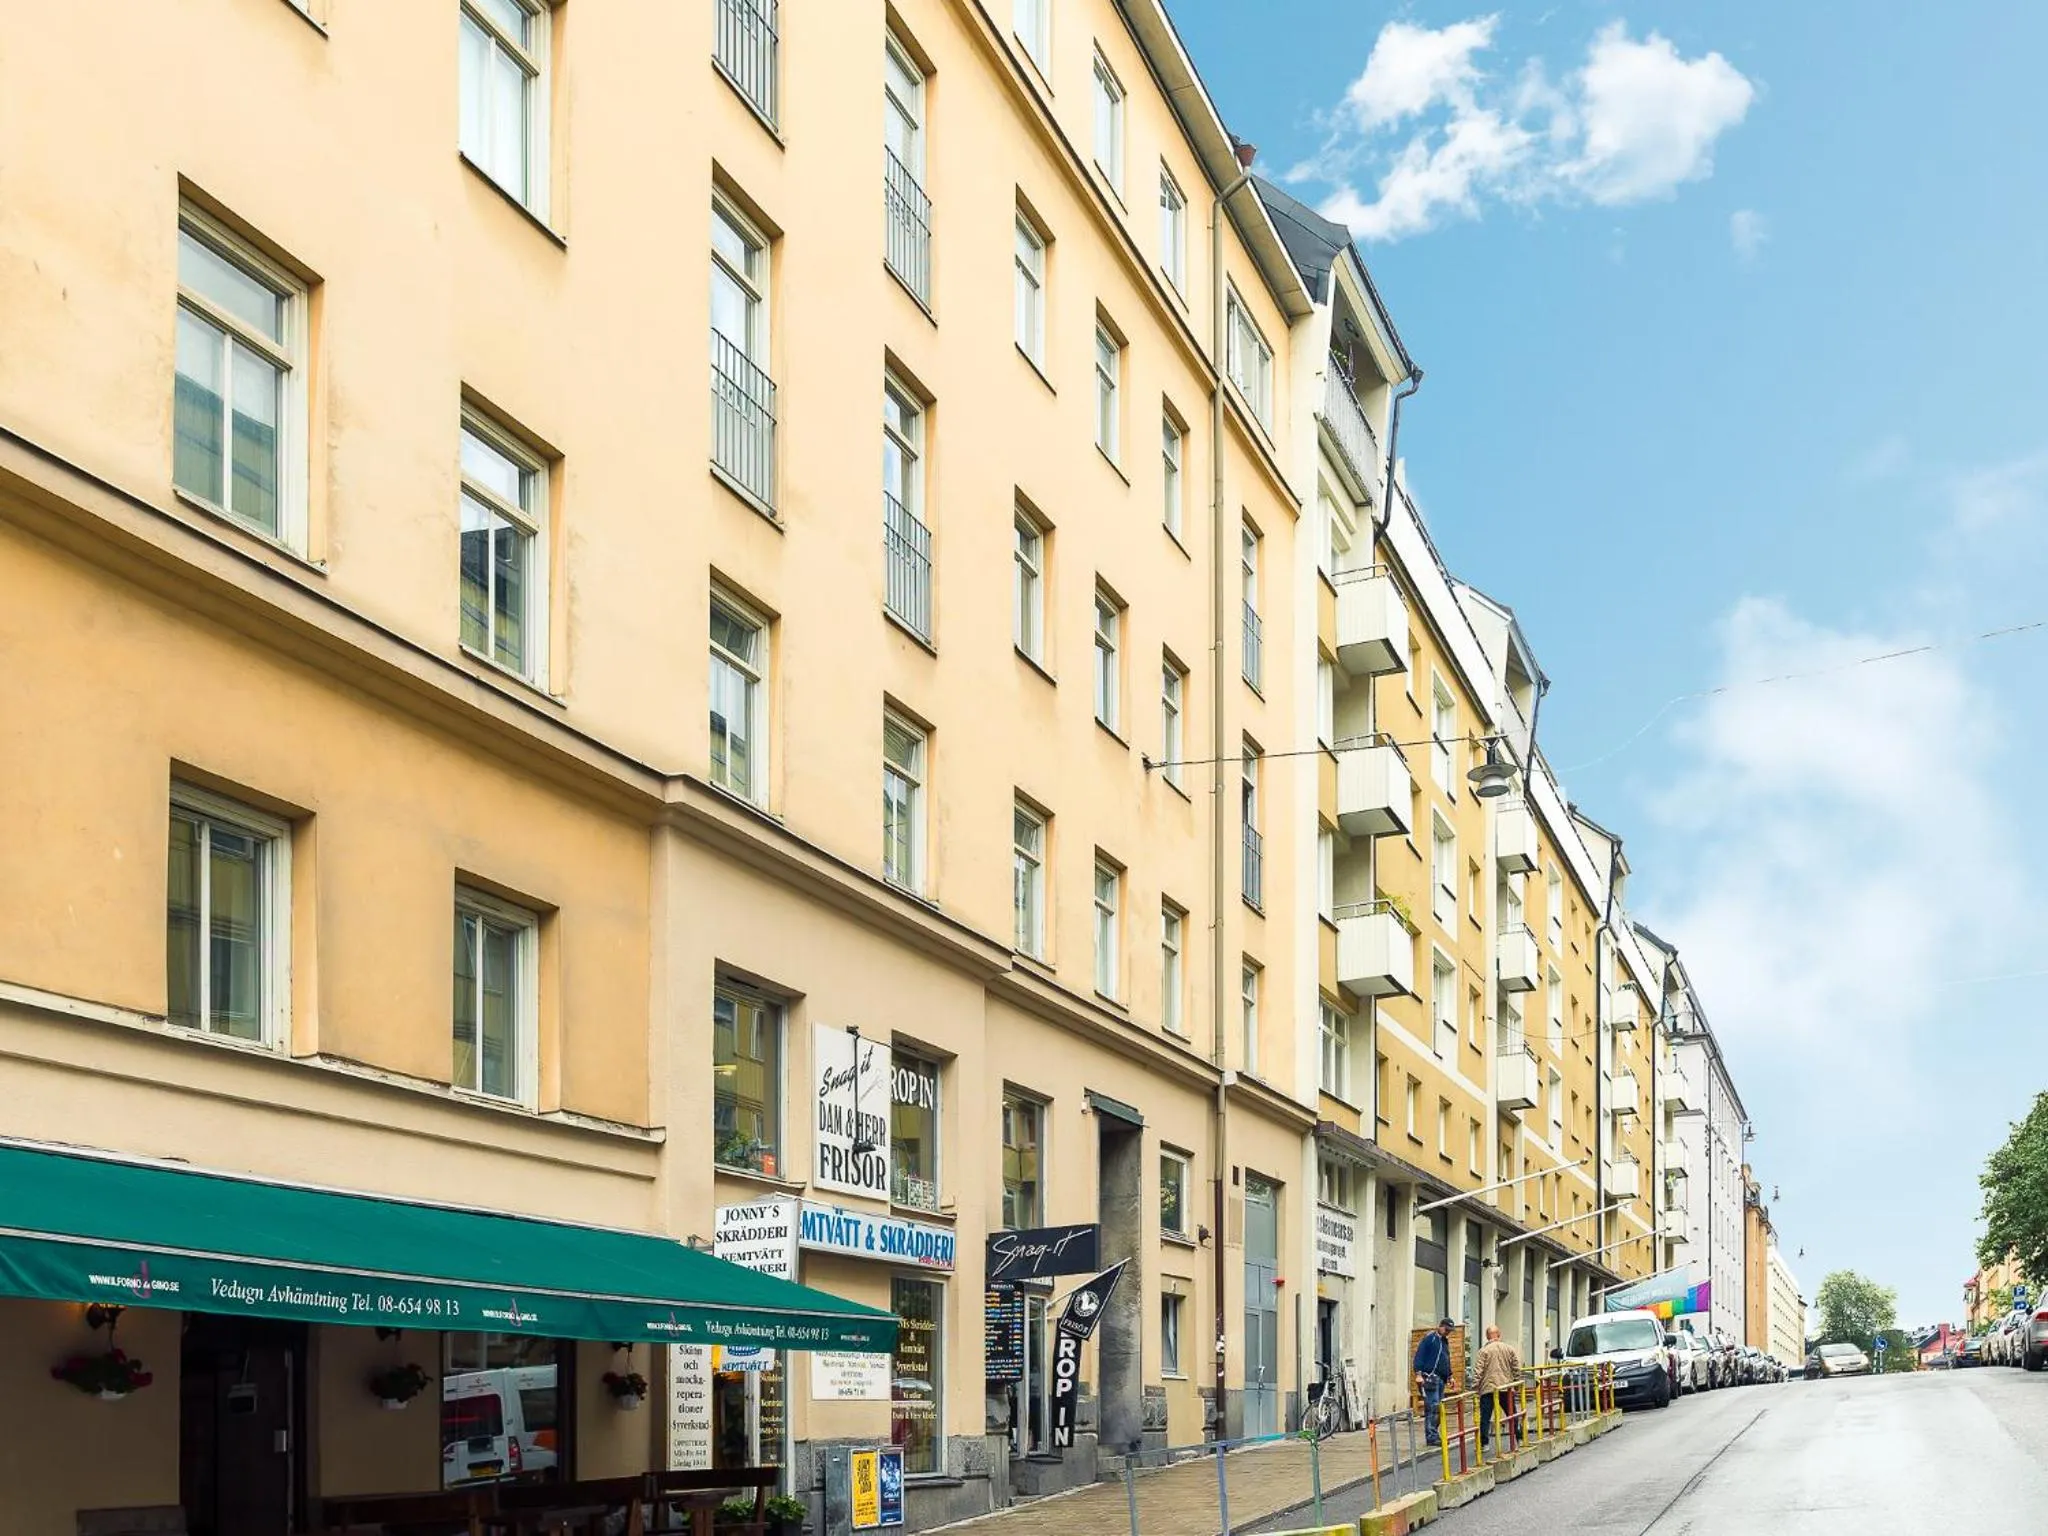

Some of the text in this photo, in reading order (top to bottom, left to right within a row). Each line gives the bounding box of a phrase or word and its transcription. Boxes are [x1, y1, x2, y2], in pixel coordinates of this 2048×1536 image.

[819, 1045, 874, 1097] Snag it
[891, 1065, 934, 1111] ROP IN
[819, 1100, 887, 1147] DAM & HERR
[715, 1225, 788, 1243] SKRÄDDERI
[800, 1208, 954, 1261] MTVÄTT & SKRÄDDERI
[721, 1247, 784, 1262] KEMTVÄTT
[747, 1263, 787, 1273] AKERI
[211, 1278, 460, 1316] Vedugn Avhämtning Tel. 08-654 98 13
[683, 1360, 698, 1370] och
[1054, 1407, 1069, 1446] IN
